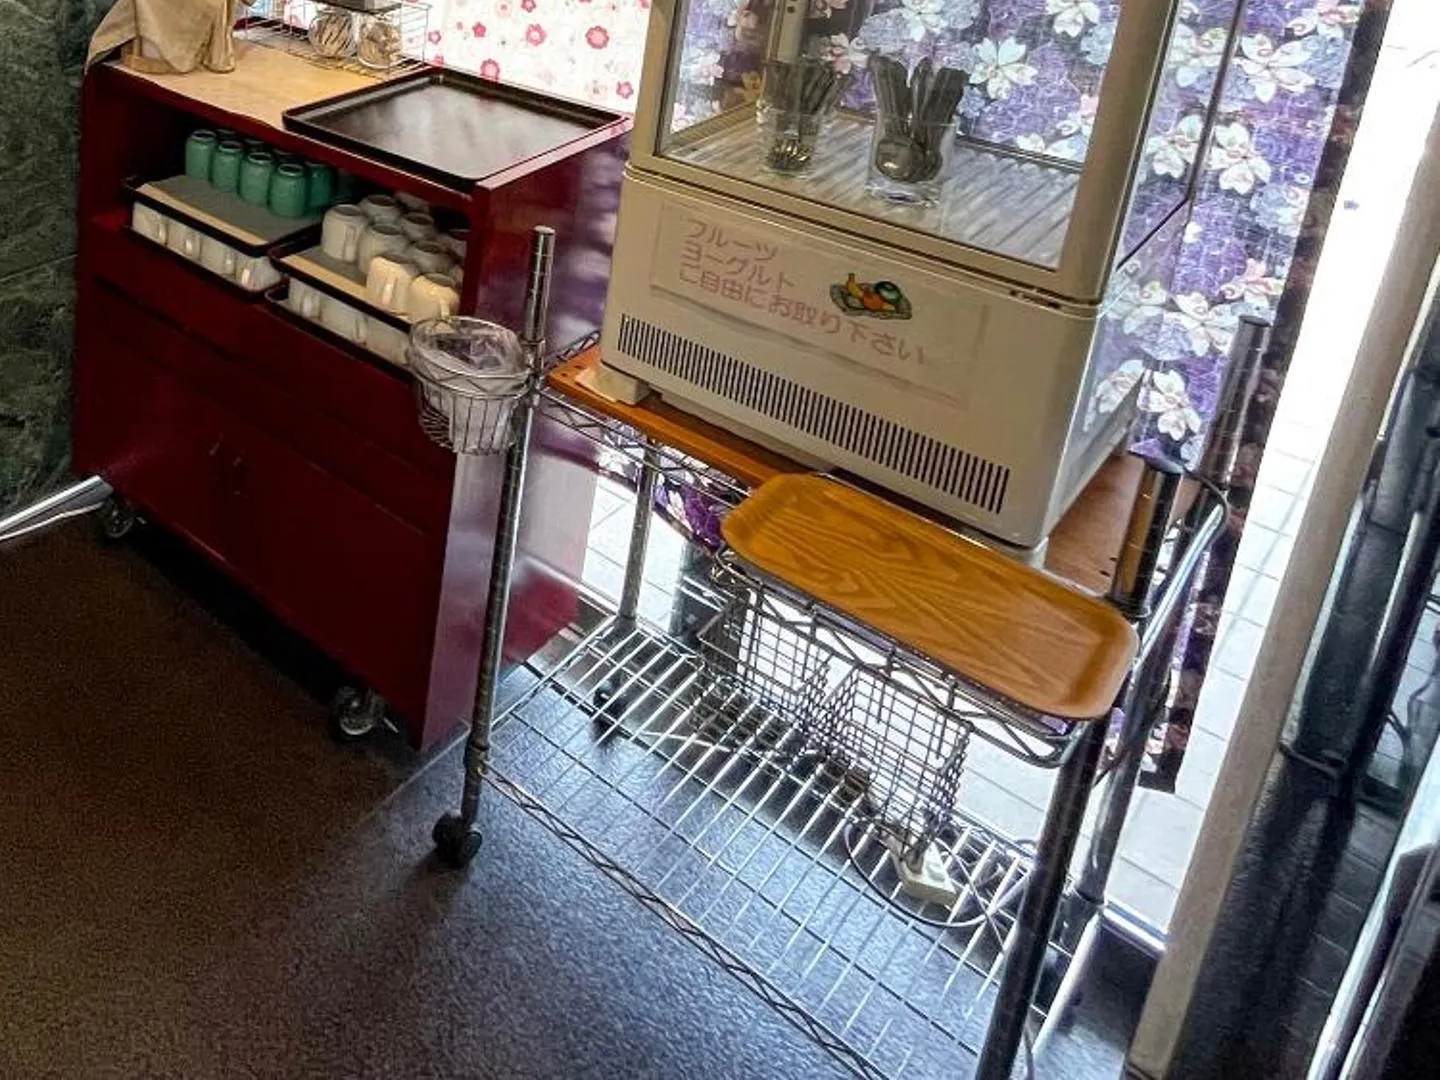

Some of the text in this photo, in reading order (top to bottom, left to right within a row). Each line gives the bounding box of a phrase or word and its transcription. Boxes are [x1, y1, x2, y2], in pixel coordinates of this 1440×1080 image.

[680, 240, 796, 291] ヨーグルト
[686, 218, 778, 262] フルーツ
[678, 268, 925, 366] ご自由にお取り下さい
